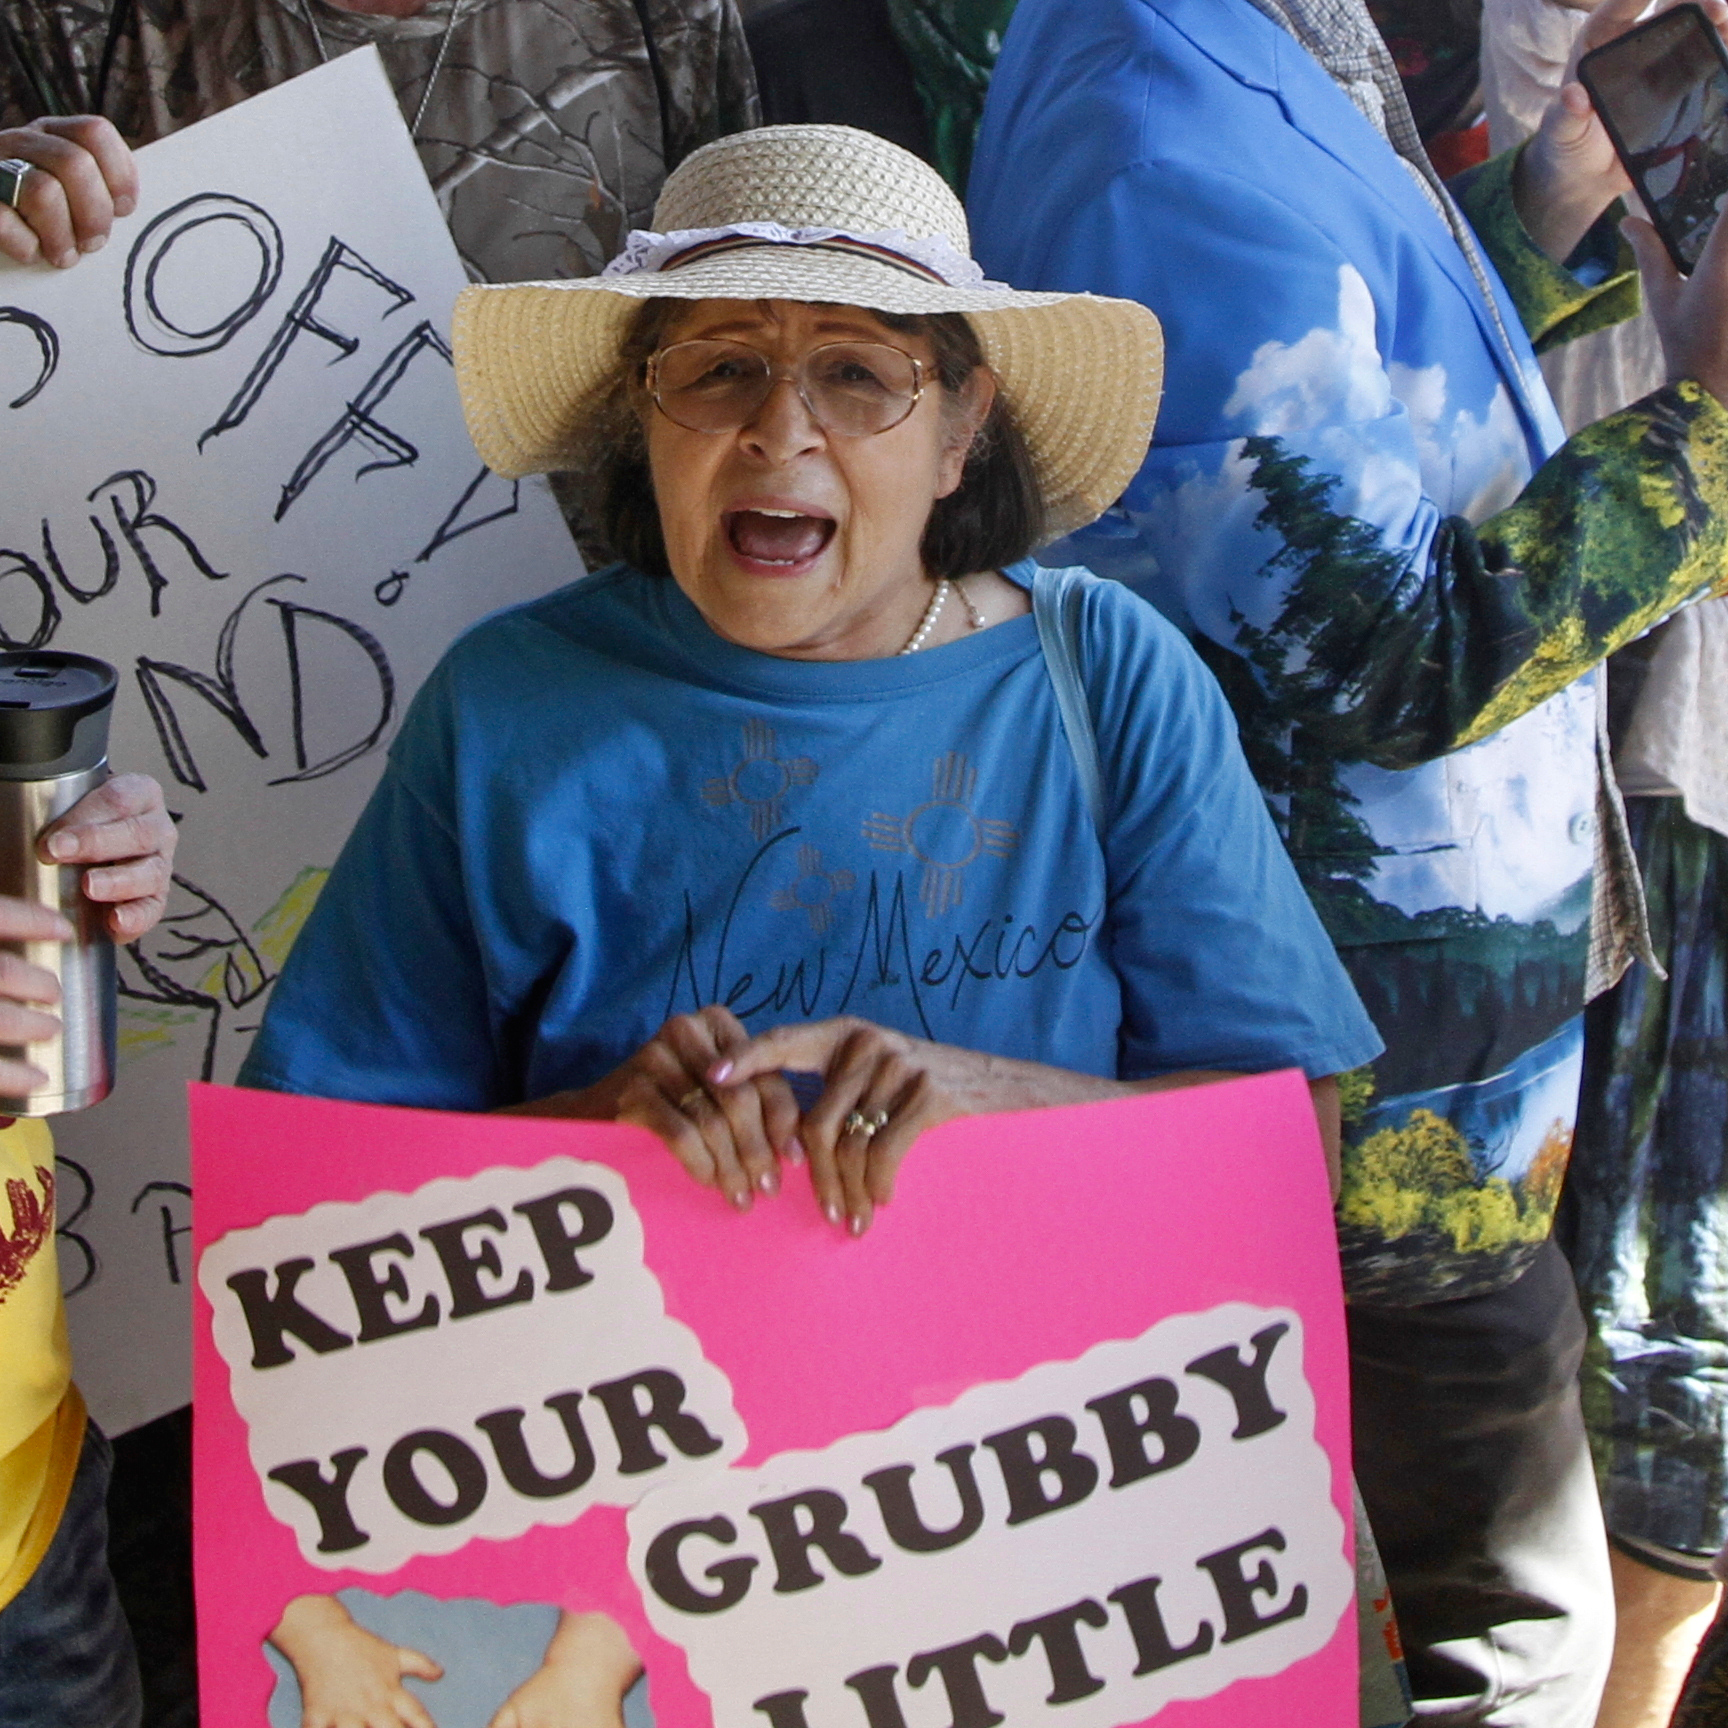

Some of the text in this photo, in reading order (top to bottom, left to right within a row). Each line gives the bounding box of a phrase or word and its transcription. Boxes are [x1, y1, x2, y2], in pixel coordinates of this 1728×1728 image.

[664, 826, 1101, 1042] New Mexico
[225, 1186, 616, 1372] KEEP
[267, 1366, 726, 1556] YOUR
[642, 1320, 1293, 1617] GRUBBY
